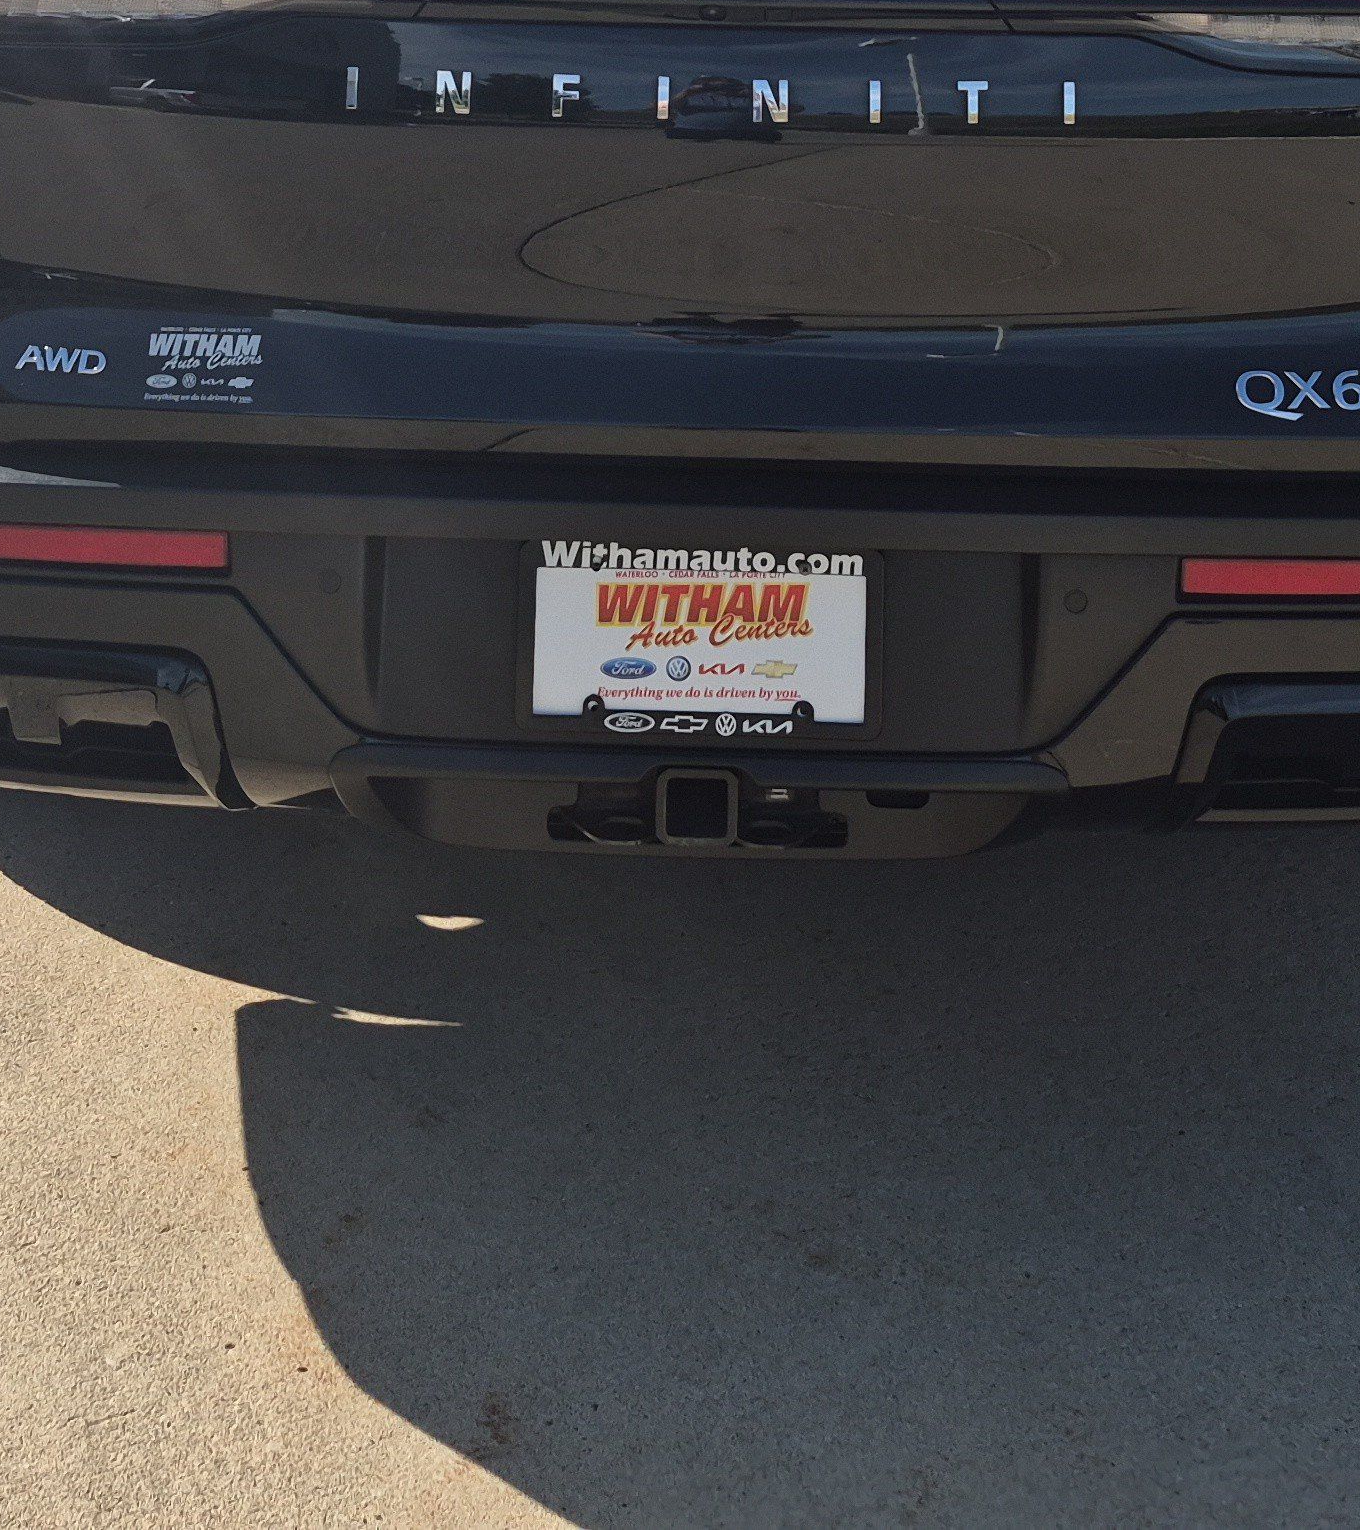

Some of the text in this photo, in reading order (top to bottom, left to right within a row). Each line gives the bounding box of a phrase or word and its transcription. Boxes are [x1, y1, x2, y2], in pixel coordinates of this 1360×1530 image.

[345, 66, 1077, 125] INFINITI
[14, 344, 107, 375] AWD
[148, 333, 262, 357] WITHAM
[161, 351, 263, 371] Auto Centers
[541, 539, 864, 576] Withamauto.com
[597, 582, 809, 626] WITHAM
[625, 615, 814, 651] Auto Centers
[597, 686, 664, 701] Everything
[665, 689, 683, 698] we
[684, 686, 701, 698] do
[703, 686, 713, 698] is
[715, 686, 756, 699] driven
[758, 686, 774, 701] by
